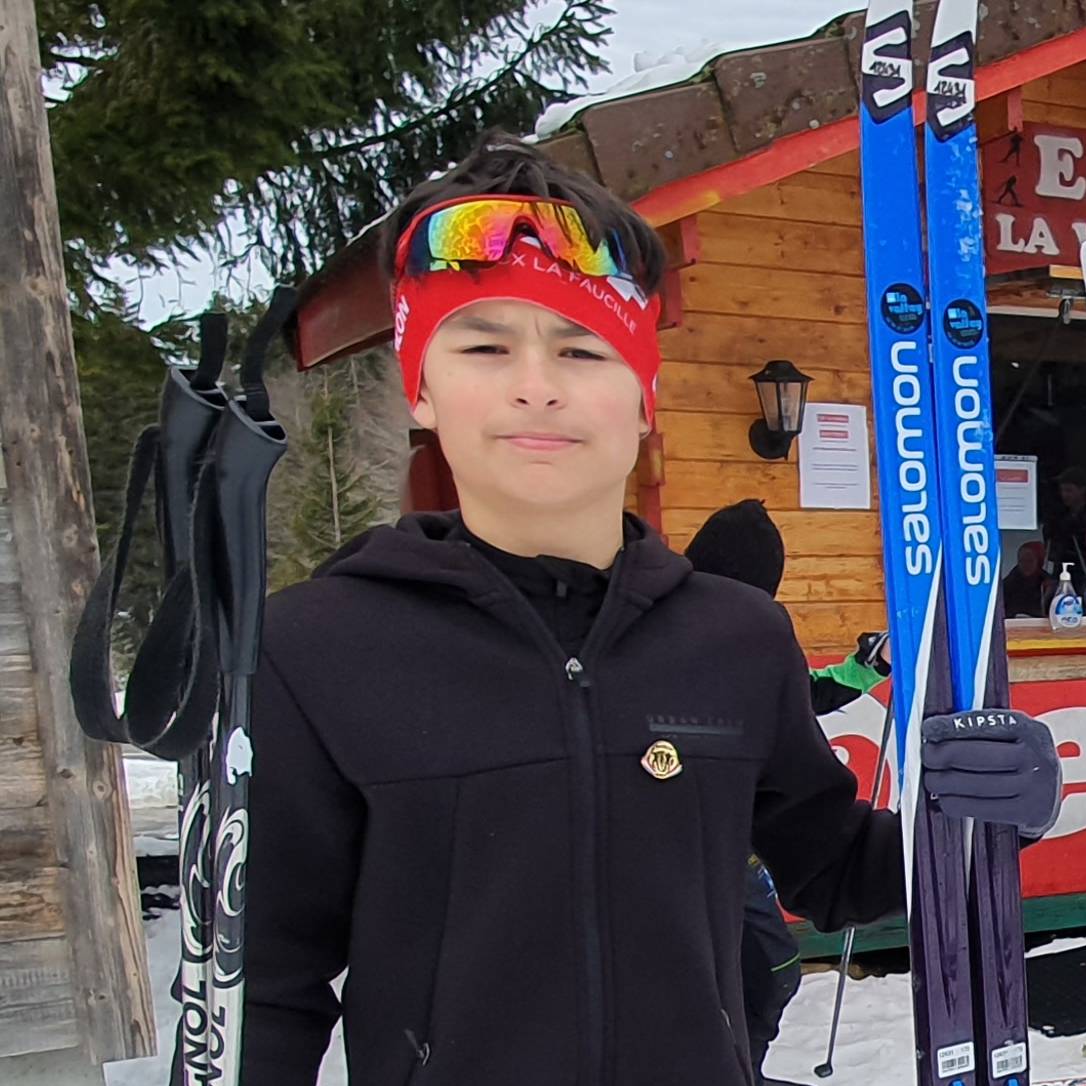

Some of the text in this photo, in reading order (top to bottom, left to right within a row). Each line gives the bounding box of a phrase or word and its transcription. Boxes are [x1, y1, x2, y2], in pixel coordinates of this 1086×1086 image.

[995, 212, 1060, 255] LA
[533, 257, 563, 279] LA
[890, 340, 933, 576] salomon
[952, 355, 992, 586] salomon
[953, 714, 1017, 729] KIPSTA
